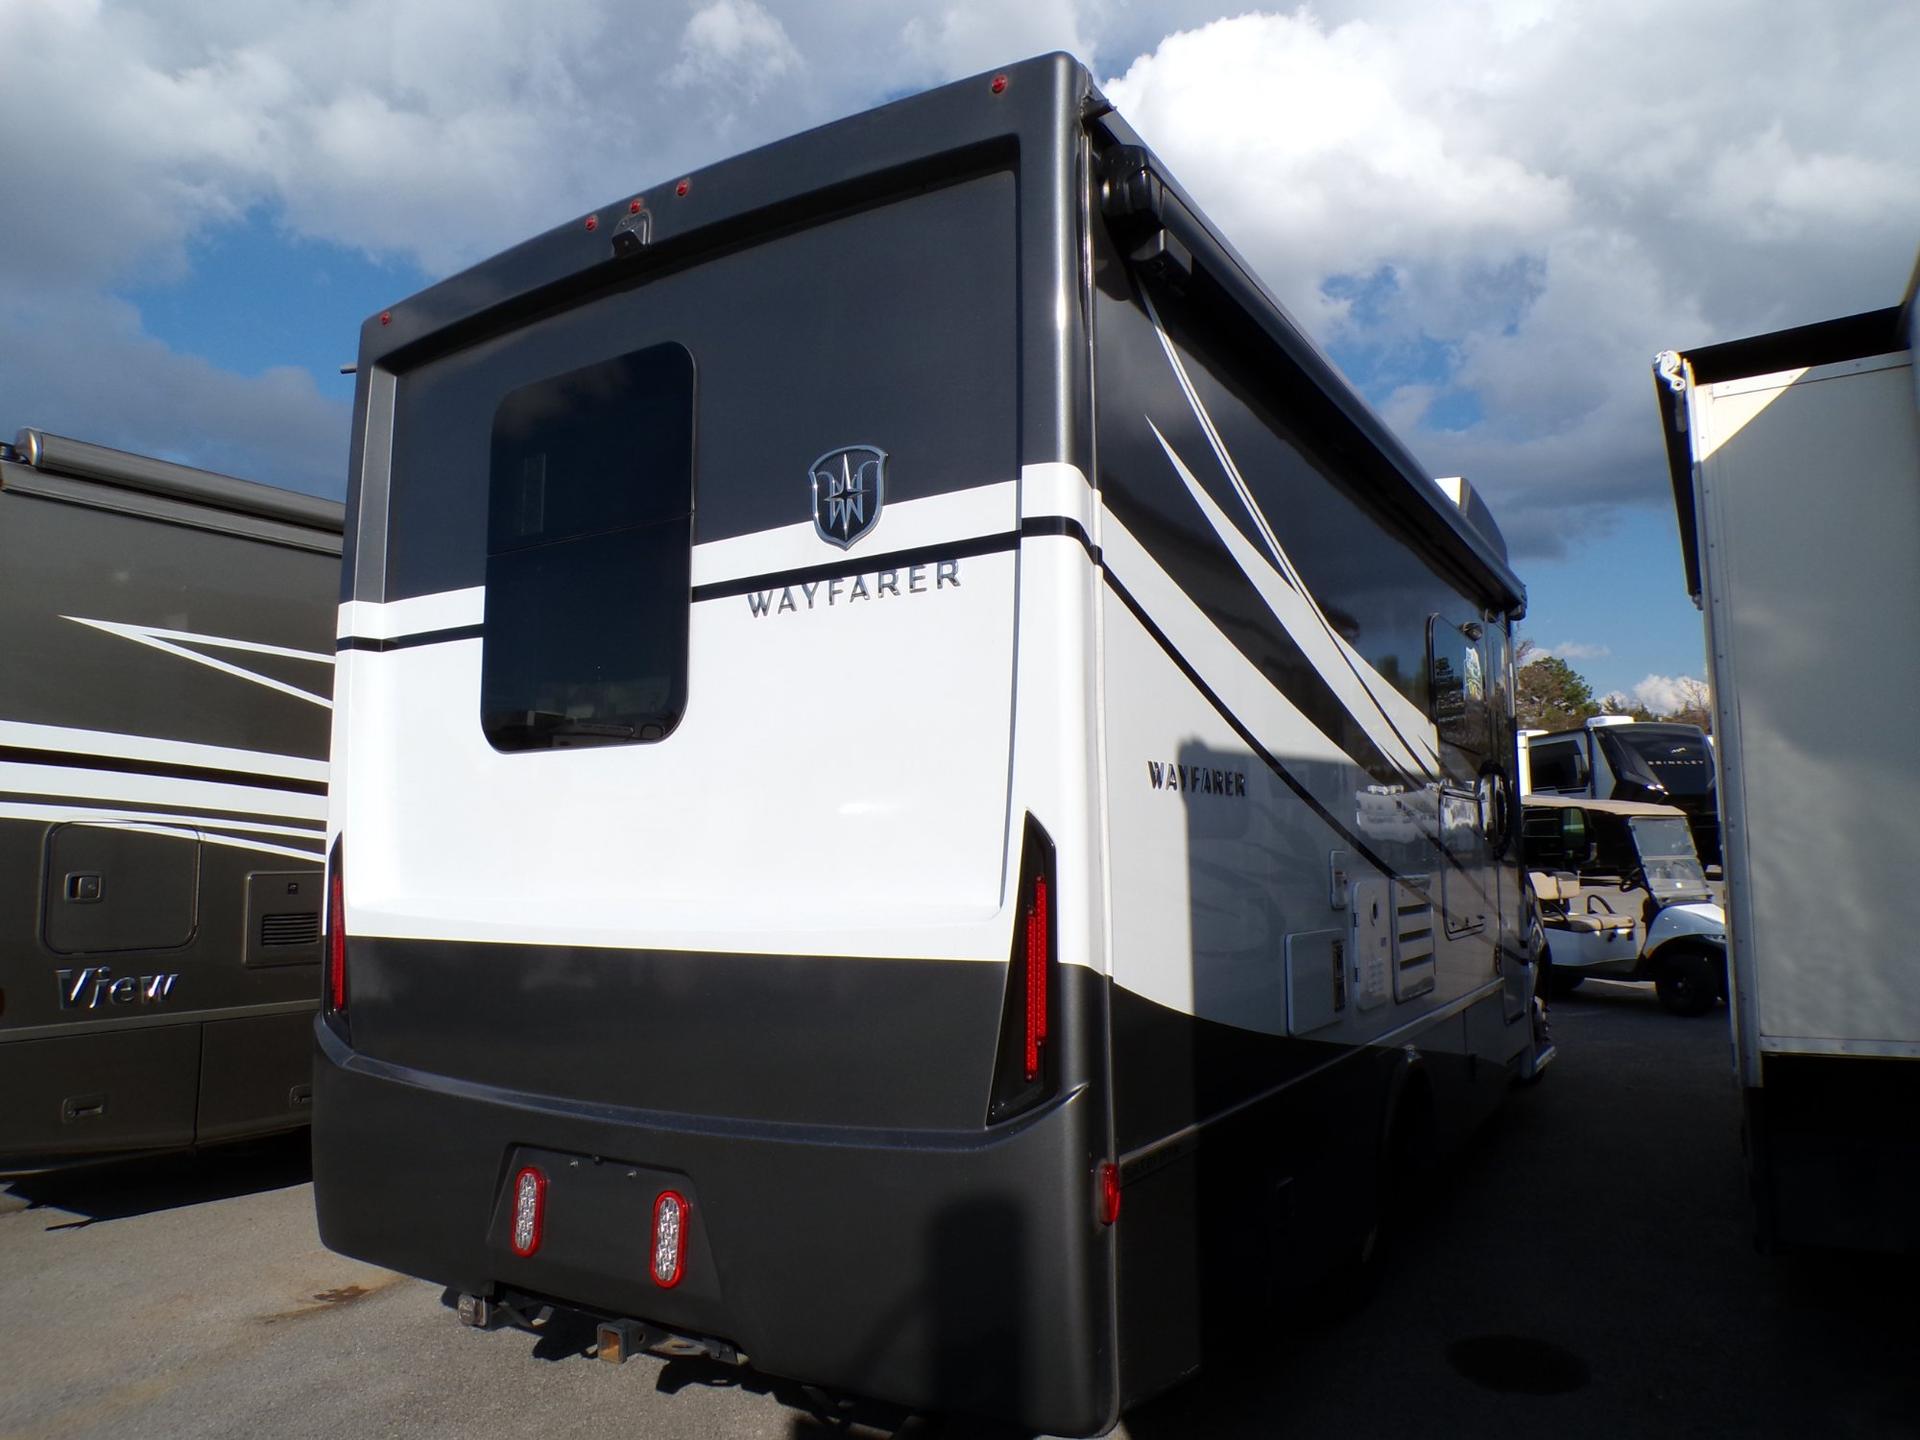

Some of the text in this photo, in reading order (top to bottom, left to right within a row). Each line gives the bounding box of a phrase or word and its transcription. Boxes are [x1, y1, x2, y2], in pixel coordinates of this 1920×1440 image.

[747, 559, 961, 618] WAYFARER
[1147, 760, 1246, 797] WAYFARER
[55, 966, 179, 1010] View
